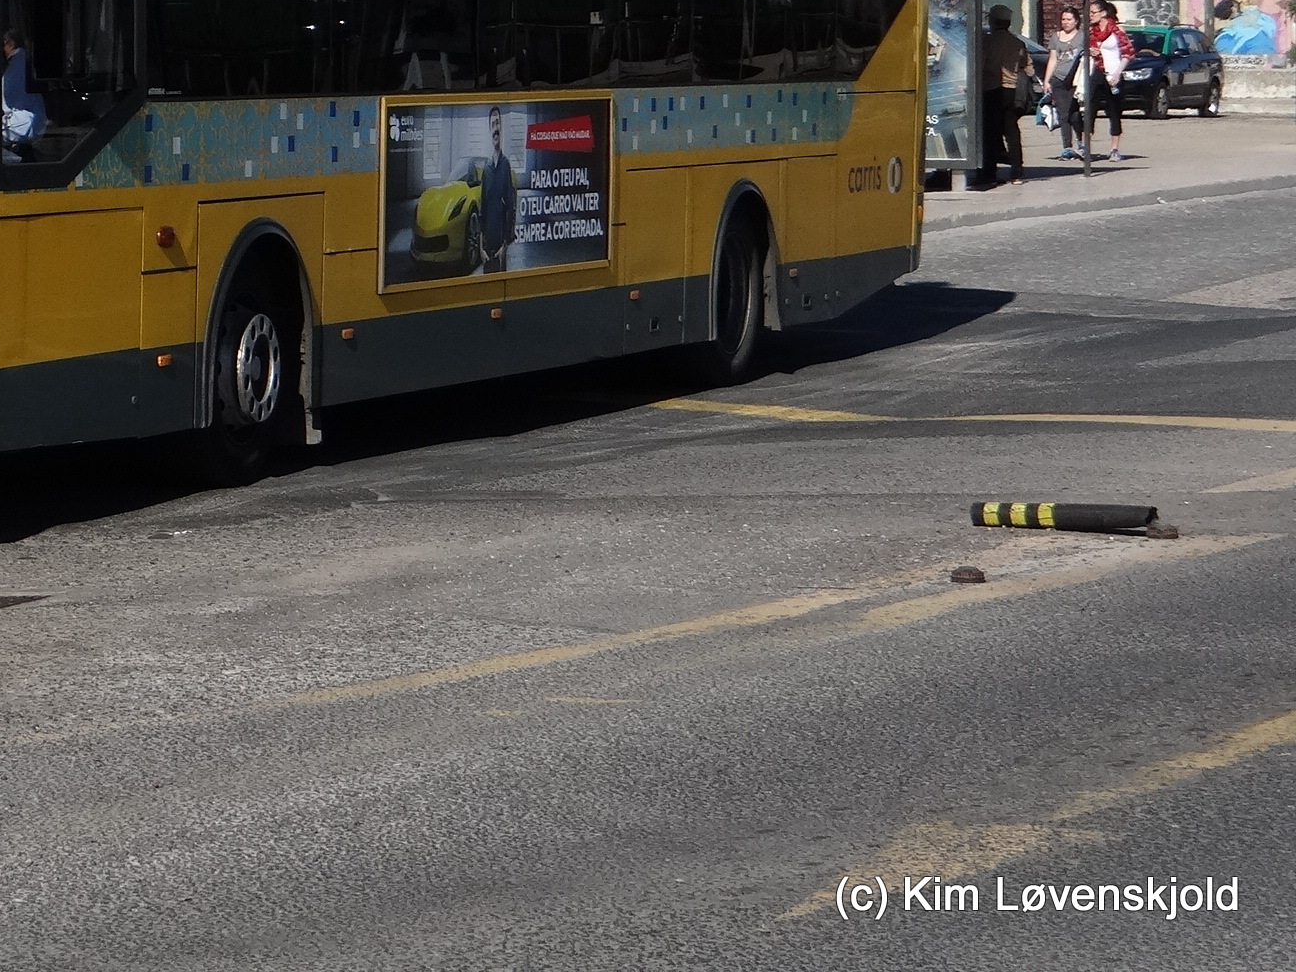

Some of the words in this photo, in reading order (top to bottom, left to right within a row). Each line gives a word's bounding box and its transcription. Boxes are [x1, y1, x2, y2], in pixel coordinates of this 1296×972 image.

[530, 169, 552, 189] PARA
[552, 169, 559, 188] O
[560, 168, 575, 187] TEU
[575, 167, 590, 189] PAI,
[848, 156, 882, 193] carris
[520, 198, 527, 216] O
[527, 196, 542, 215] TEU
[543, 194, 571, 214] CARRO
[571, 193, 584, 212] VAI
[584, 192, 599, 211] TER
[514, 222, 546, 243] SEMPRE
[546, 222, 552, 241] A
[552, 220, 570, 240] COR
[571, 218, 604, 239] ERRADA.
